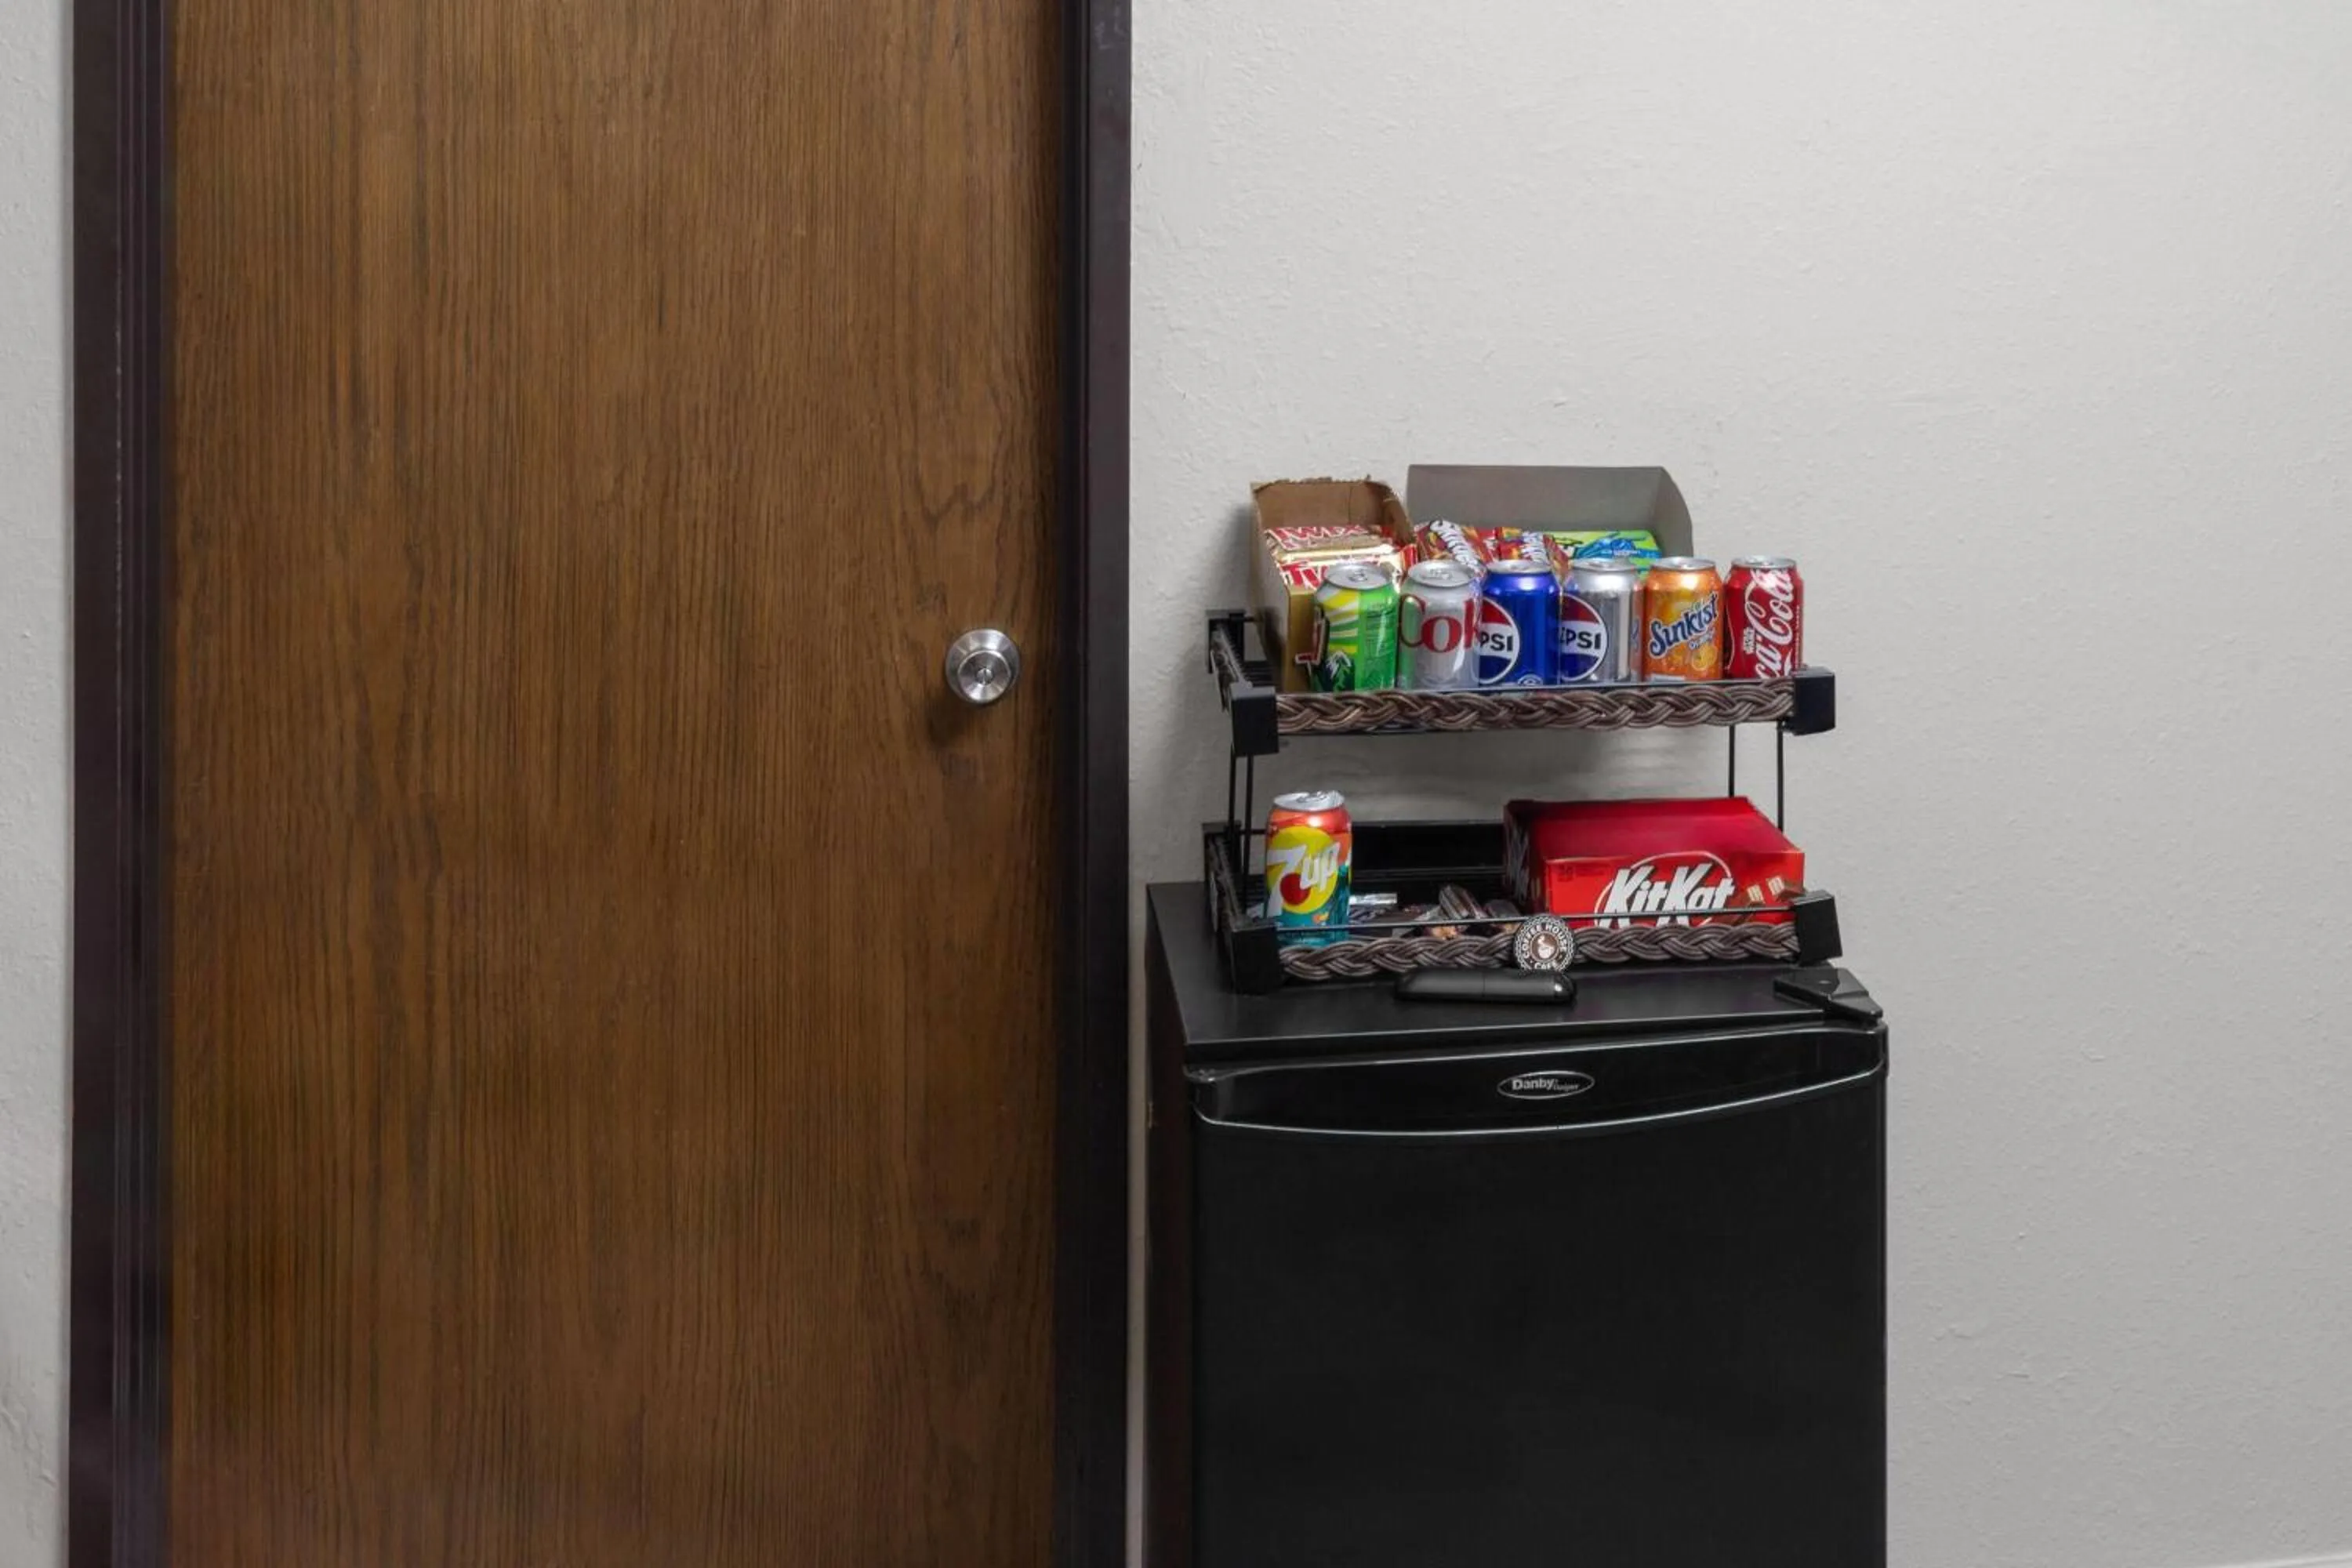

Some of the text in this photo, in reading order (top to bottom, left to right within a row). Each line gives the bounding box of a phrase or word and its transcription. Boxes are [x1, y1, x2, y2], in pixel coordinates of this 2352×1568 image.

[1399, 593, 1479, 654] Cok
[1649, 592, 1718, 658] Sunkist
[1479, 630, 1514, 652] PSI
[1561, 627, 1602, 650] PSI
[1512, 1079, 1555, 1091] Danby
